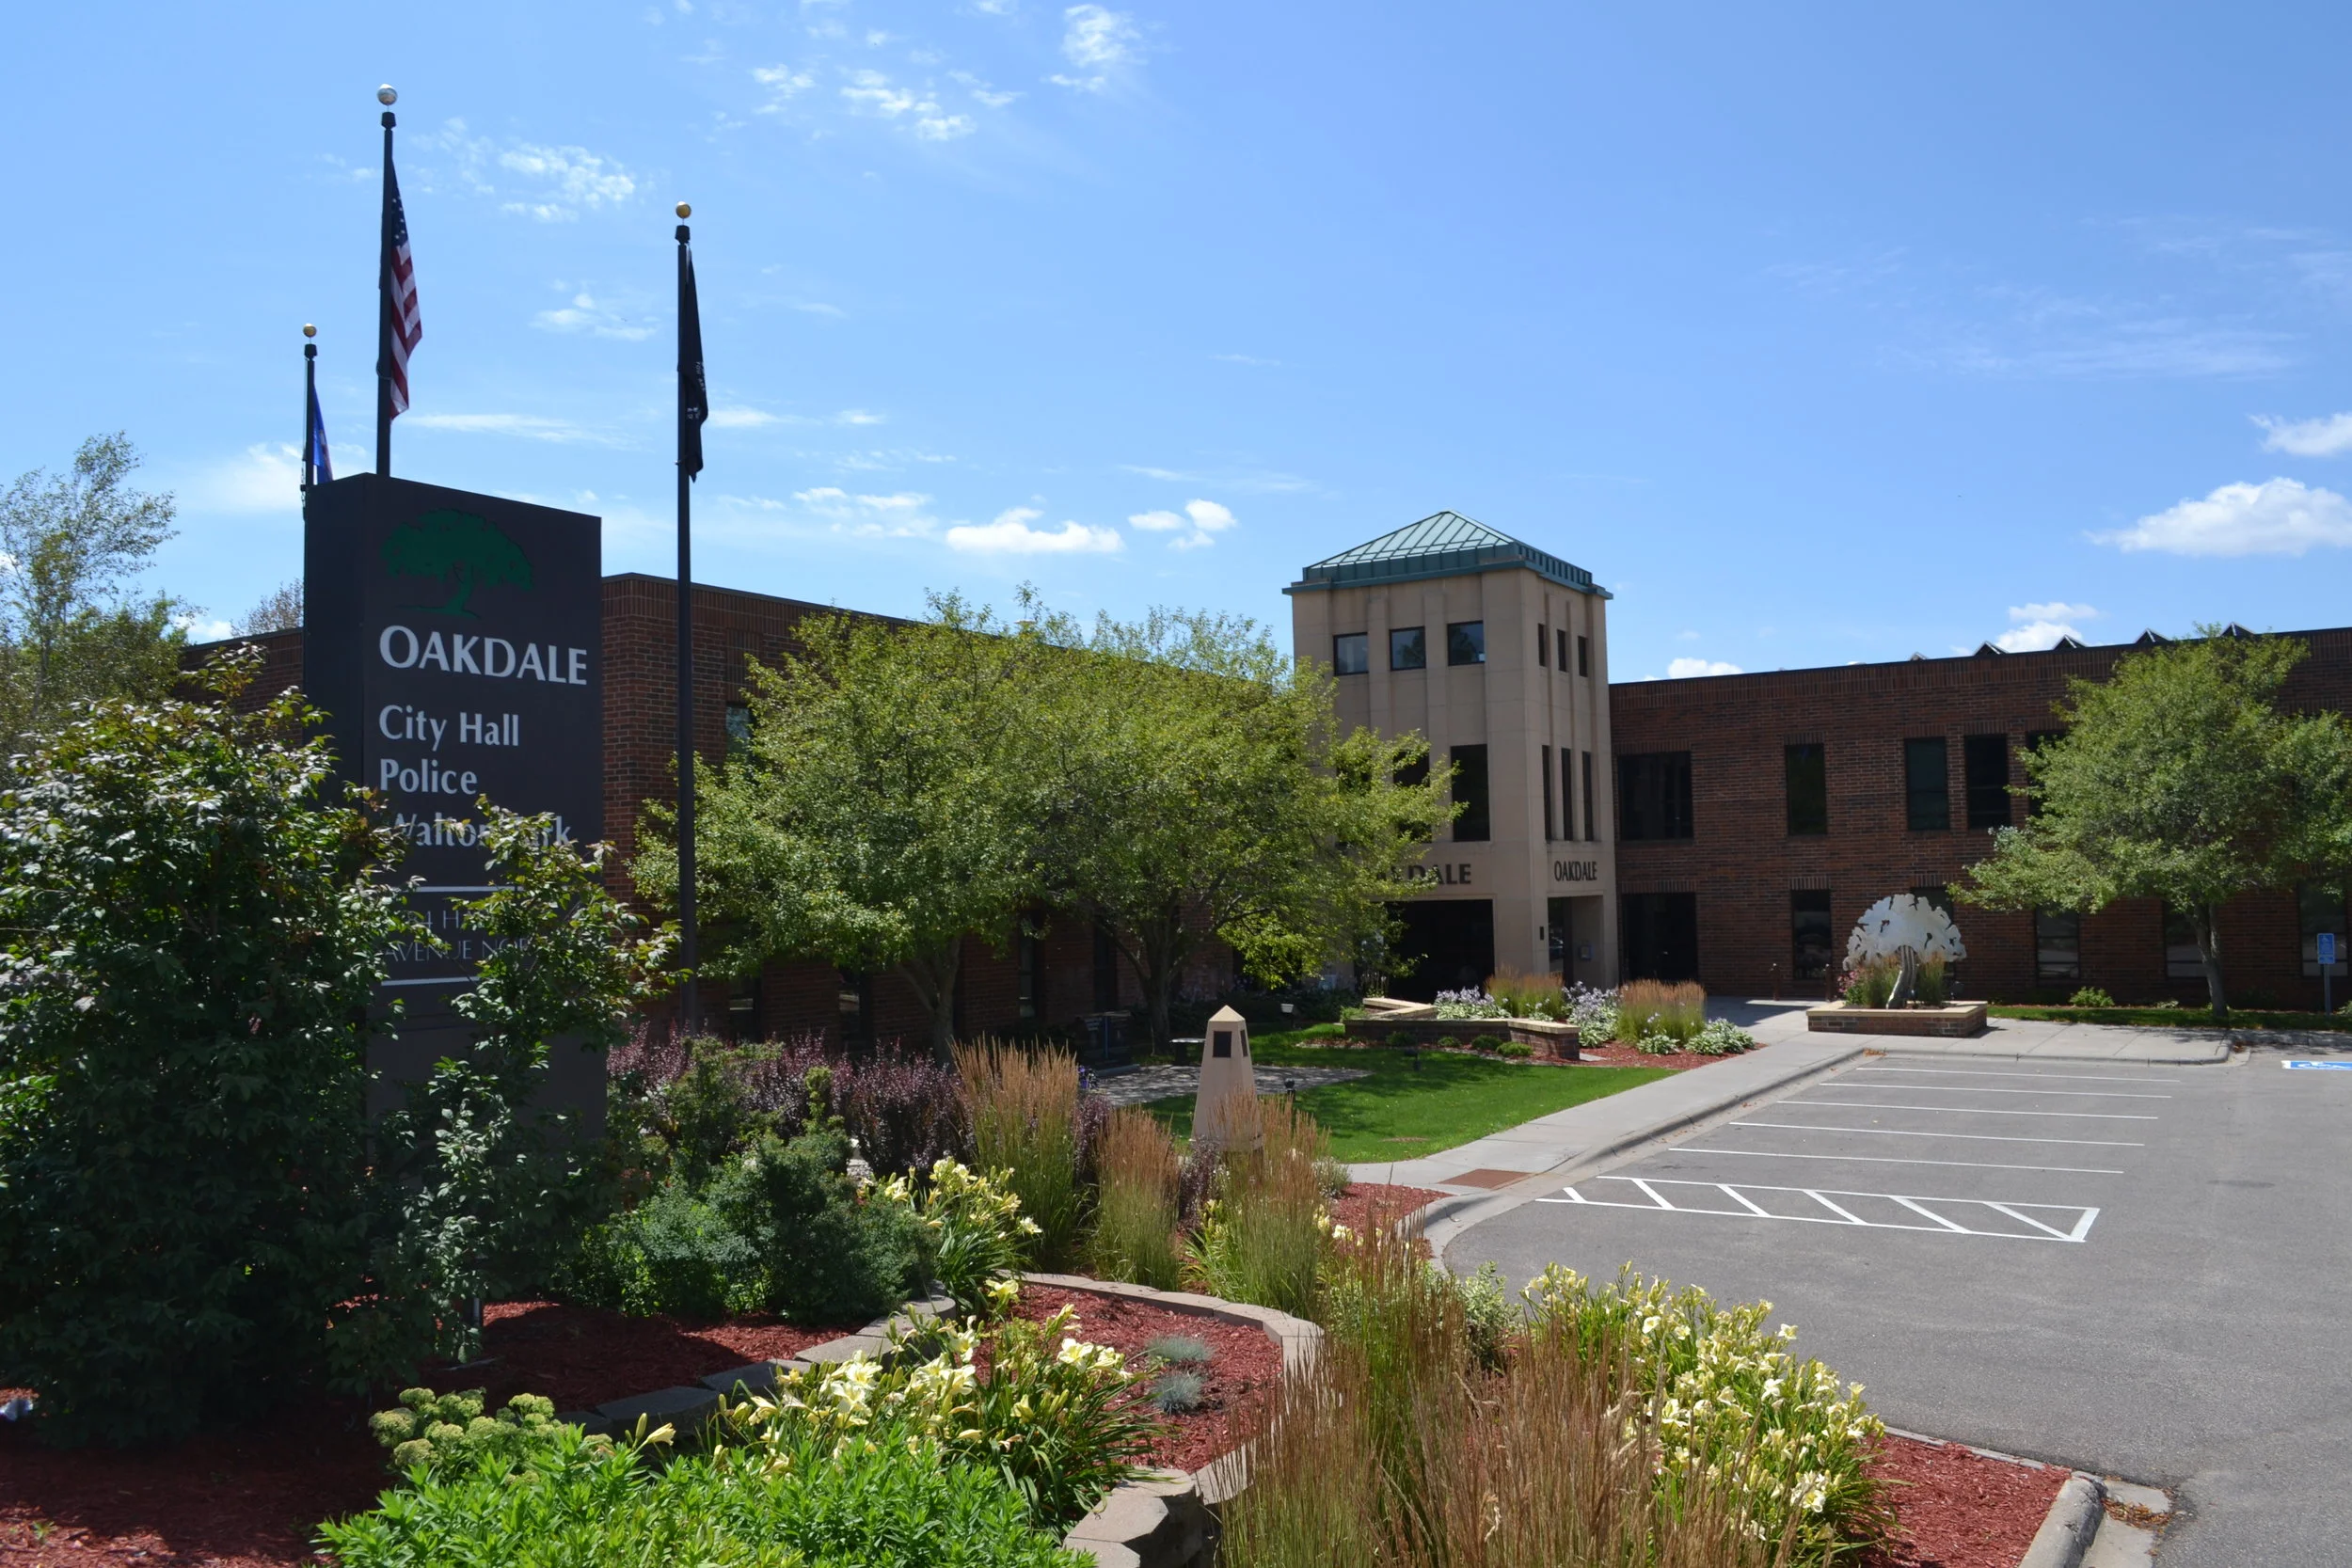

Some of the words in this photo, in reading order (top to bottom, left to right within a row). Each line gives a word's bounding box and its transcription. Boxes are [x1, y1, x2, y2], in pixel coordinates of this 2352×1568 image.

[378, 624, 588, 686] OAKDALE
[378, 704, 447, 752] City
[459, 710, 520, 748] Hall
[379, 758, 478, 796] Police
[1553, 860, 1597, 881] OAKDALE
[482, 937, 534, 958] NOR
